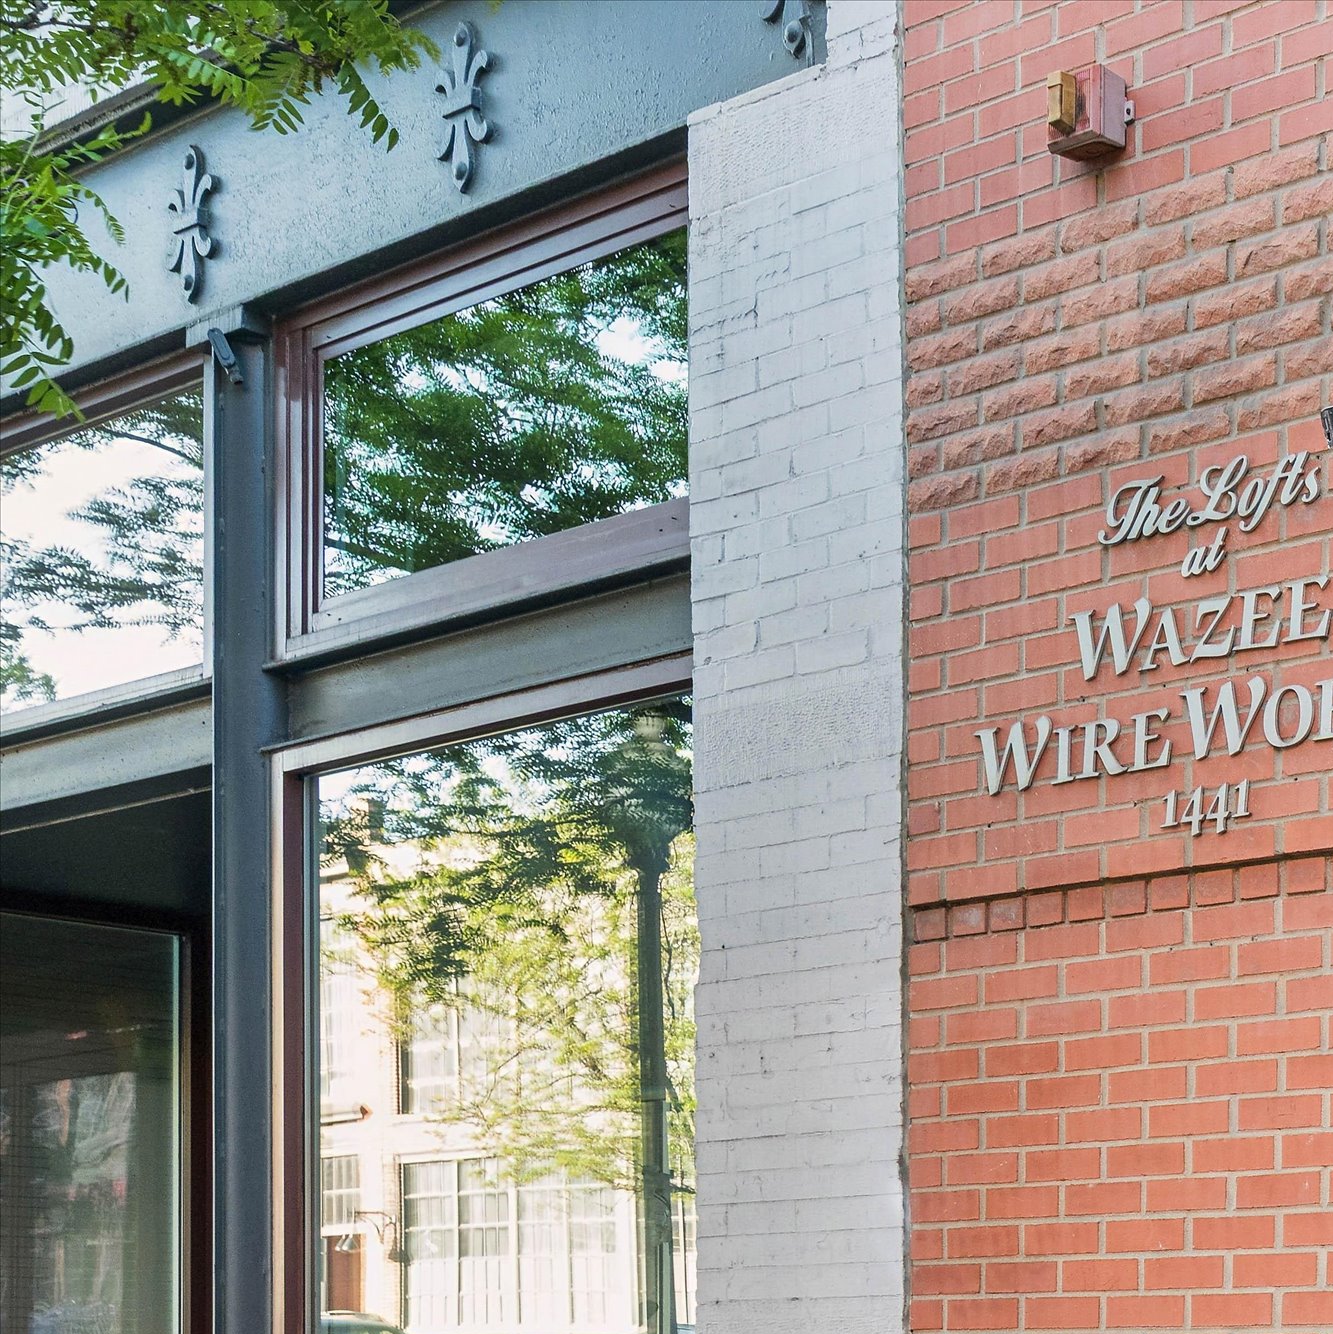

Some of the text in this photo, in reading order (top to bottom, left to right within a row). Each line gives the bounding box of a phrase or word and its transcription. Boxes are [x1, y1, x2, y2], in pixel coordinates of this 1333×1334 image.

[1098, 451, 1322, 546] The Lofts
[1181, 526, 1230, 578] at
[1069, 575, 1333, 682] WAZEE
[1160, 778, 1251, 836] 1441
